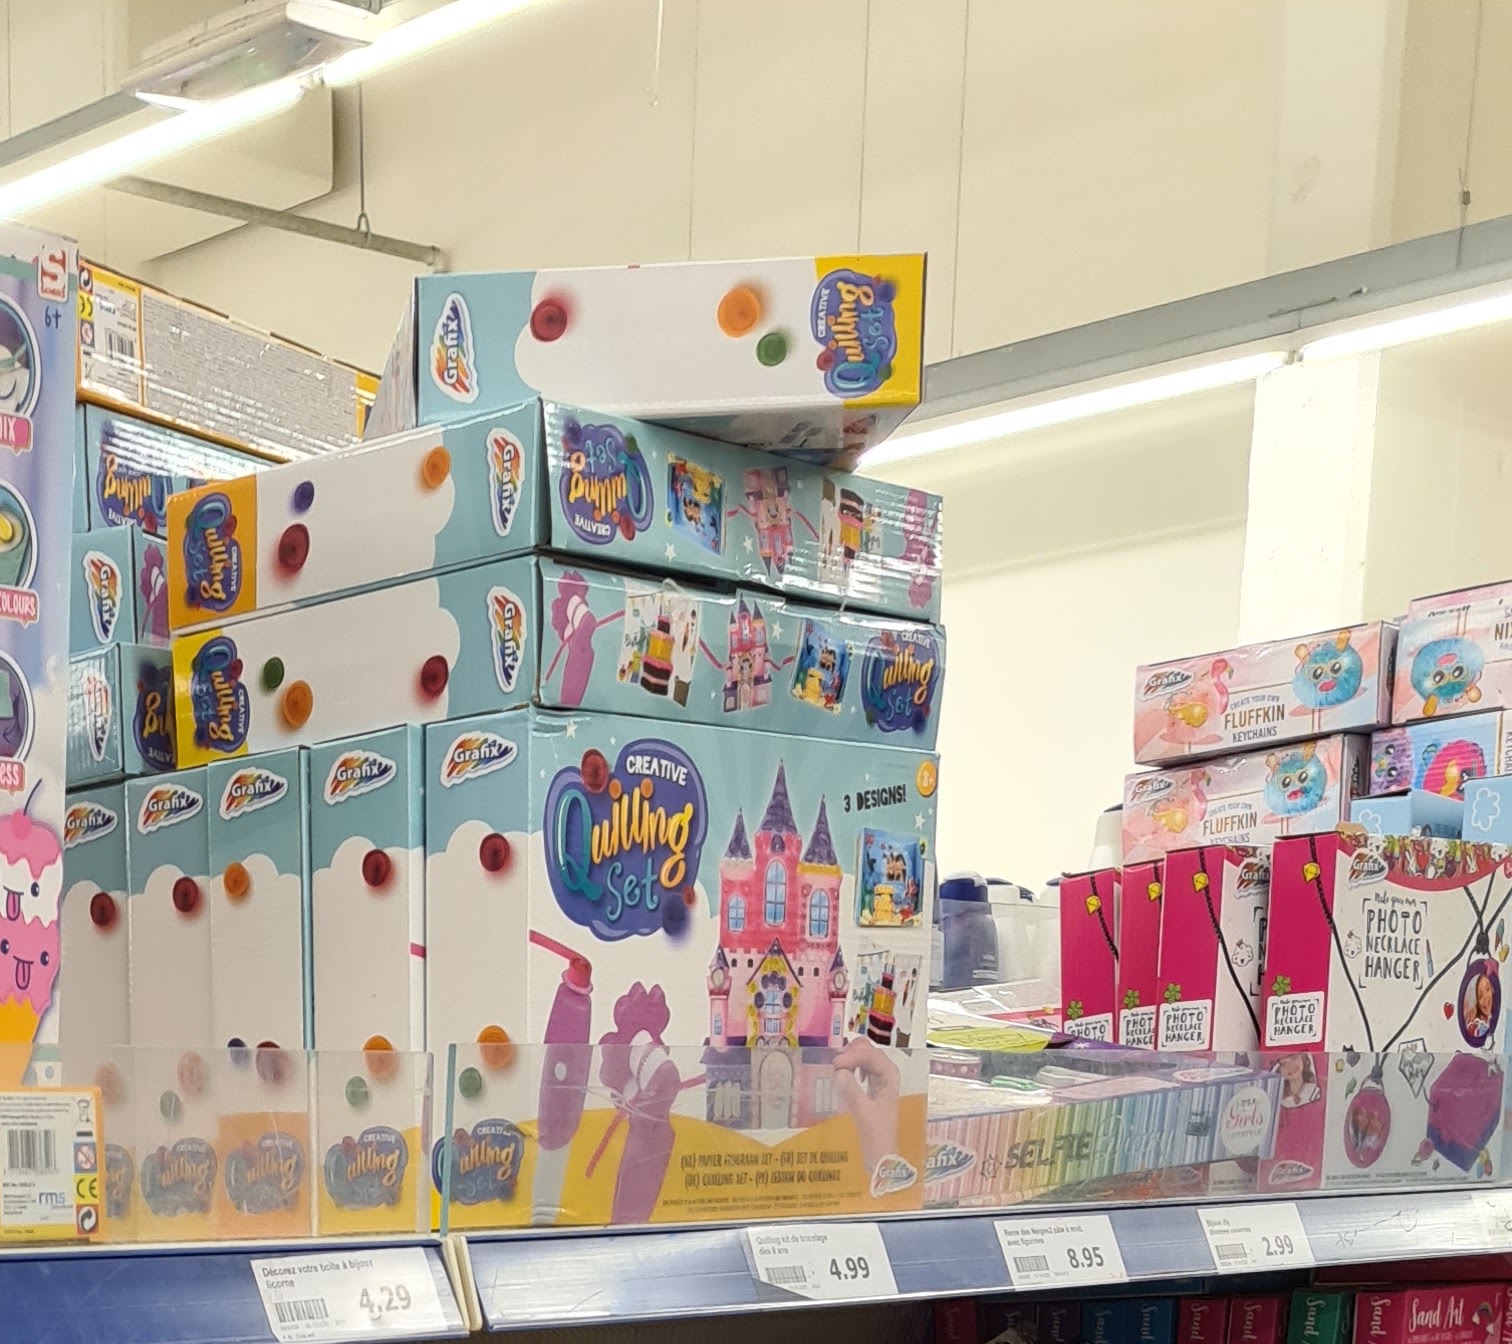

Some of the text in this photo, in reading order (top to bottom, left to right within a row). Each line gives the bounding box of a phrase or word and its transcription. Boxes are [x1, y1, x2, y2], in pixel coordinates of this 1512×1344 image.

[444, 315, 462, 386] Grafix
[1224, 703, 1286, 731] FLUFFKIN
[1232, 725, 1278, 743] KEYCHAINS
[451, 739, 507, 765] Grafix
[335, 762, 387, 789] Grafix
[624, 756, 688, 785] CREATIVE
[227, 778, 277, 802] Grafix
[844, 784, 907, 813] 3 DESIGNS!
[1203, 814, 1257, 836] FLUFFKIN
[1366, 908, 1422, 935] PHOTO
[1366, 934, 1421, 957] NECKLACE
[1365, 956, 1420, 981] HANGER
[1275, 1003, 1315, 1017] PHOTO
[1274, 1024, 1314, 1035] HANGER
[1066, 1246, 1103, 1268] 8.95
[1261, 1234, 1293, 1257] 2.99
[829, 1256, 870, 1281] 4.99
[360, 1285, 411, 1315] 4.29
[1408, 1294, 1465, 1334] Sand Art
